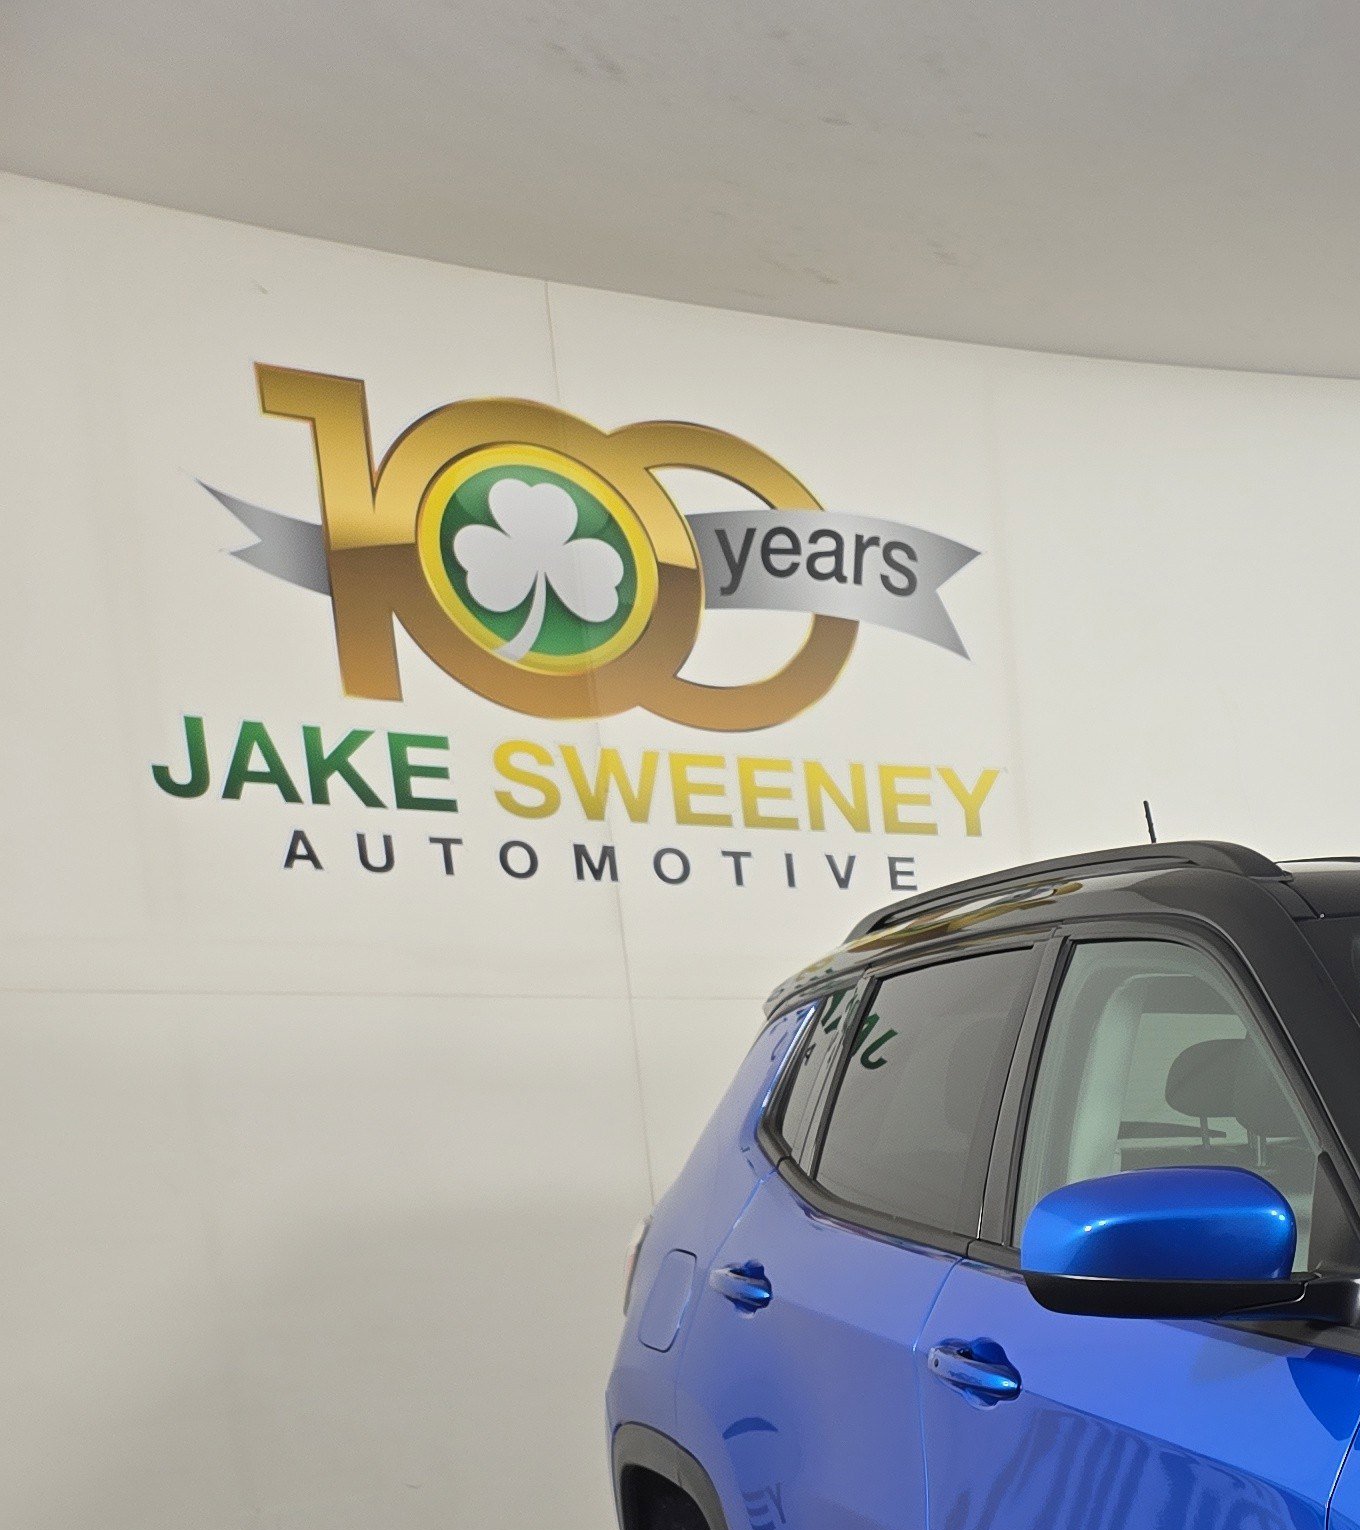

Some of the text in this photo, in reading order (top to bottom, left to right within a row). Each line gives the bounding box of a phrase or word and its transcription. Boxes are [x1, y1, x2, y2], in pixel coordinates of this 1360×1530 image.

[715, 524, 919, 597] years
[151, 715, 1000, 838] JAKE SWEENEY
[283, 830, 918, 892] AUTOMOTIVE
